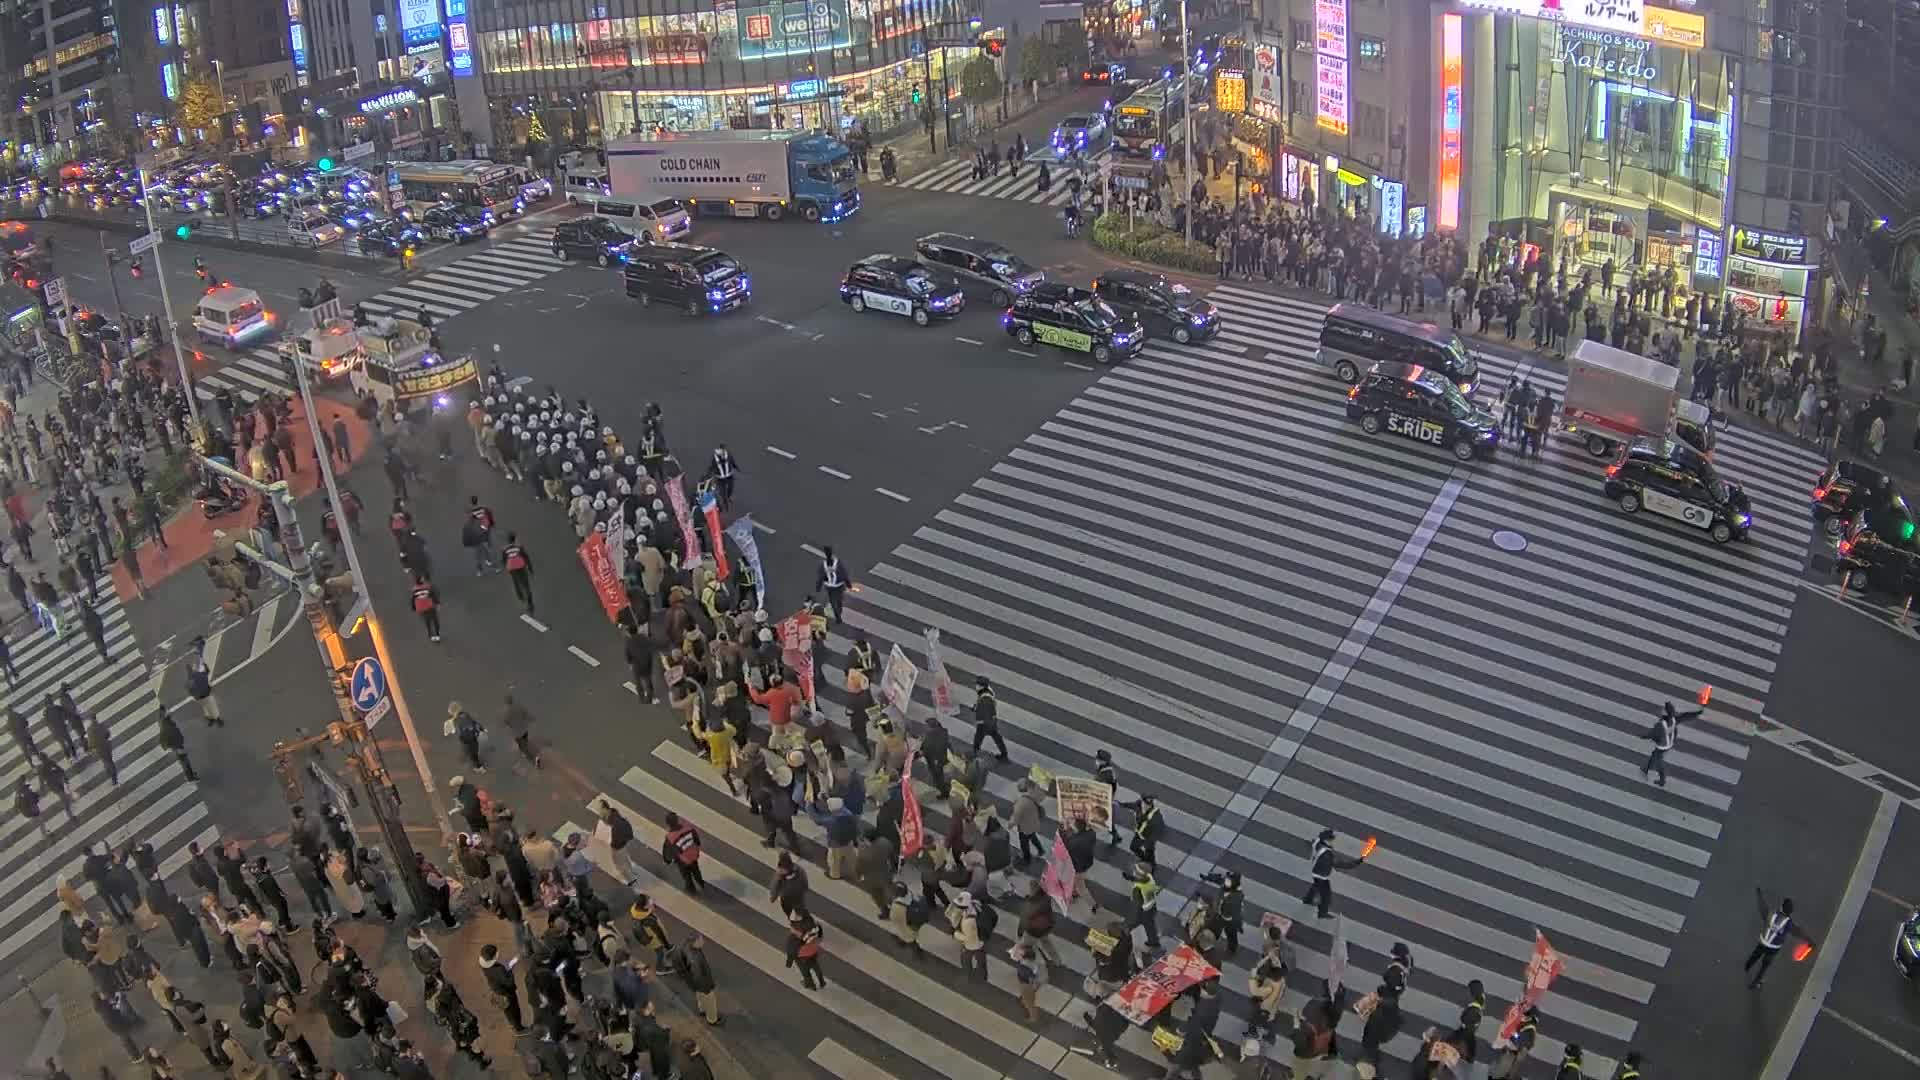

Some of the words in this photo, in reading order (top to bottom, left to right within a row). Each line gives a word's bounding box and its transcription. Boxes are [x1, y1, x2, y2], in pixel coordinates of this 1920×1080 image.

[1585, 5, 1639, 24] ルノアール
[1560, 27, 1612, 45] PACHINKO
[1614, 36, 1622, 46] &
[1624, 37, 1652, 51] SLOT
[1552, 41, 1656, 80] Kaleido
[660, 158, 687, 171] COLD
[689, 158, 721, 171] CHAIN
[1388, 417, 1443, 445] S.RIDE
[1683, 506, 1705, 524] GO
